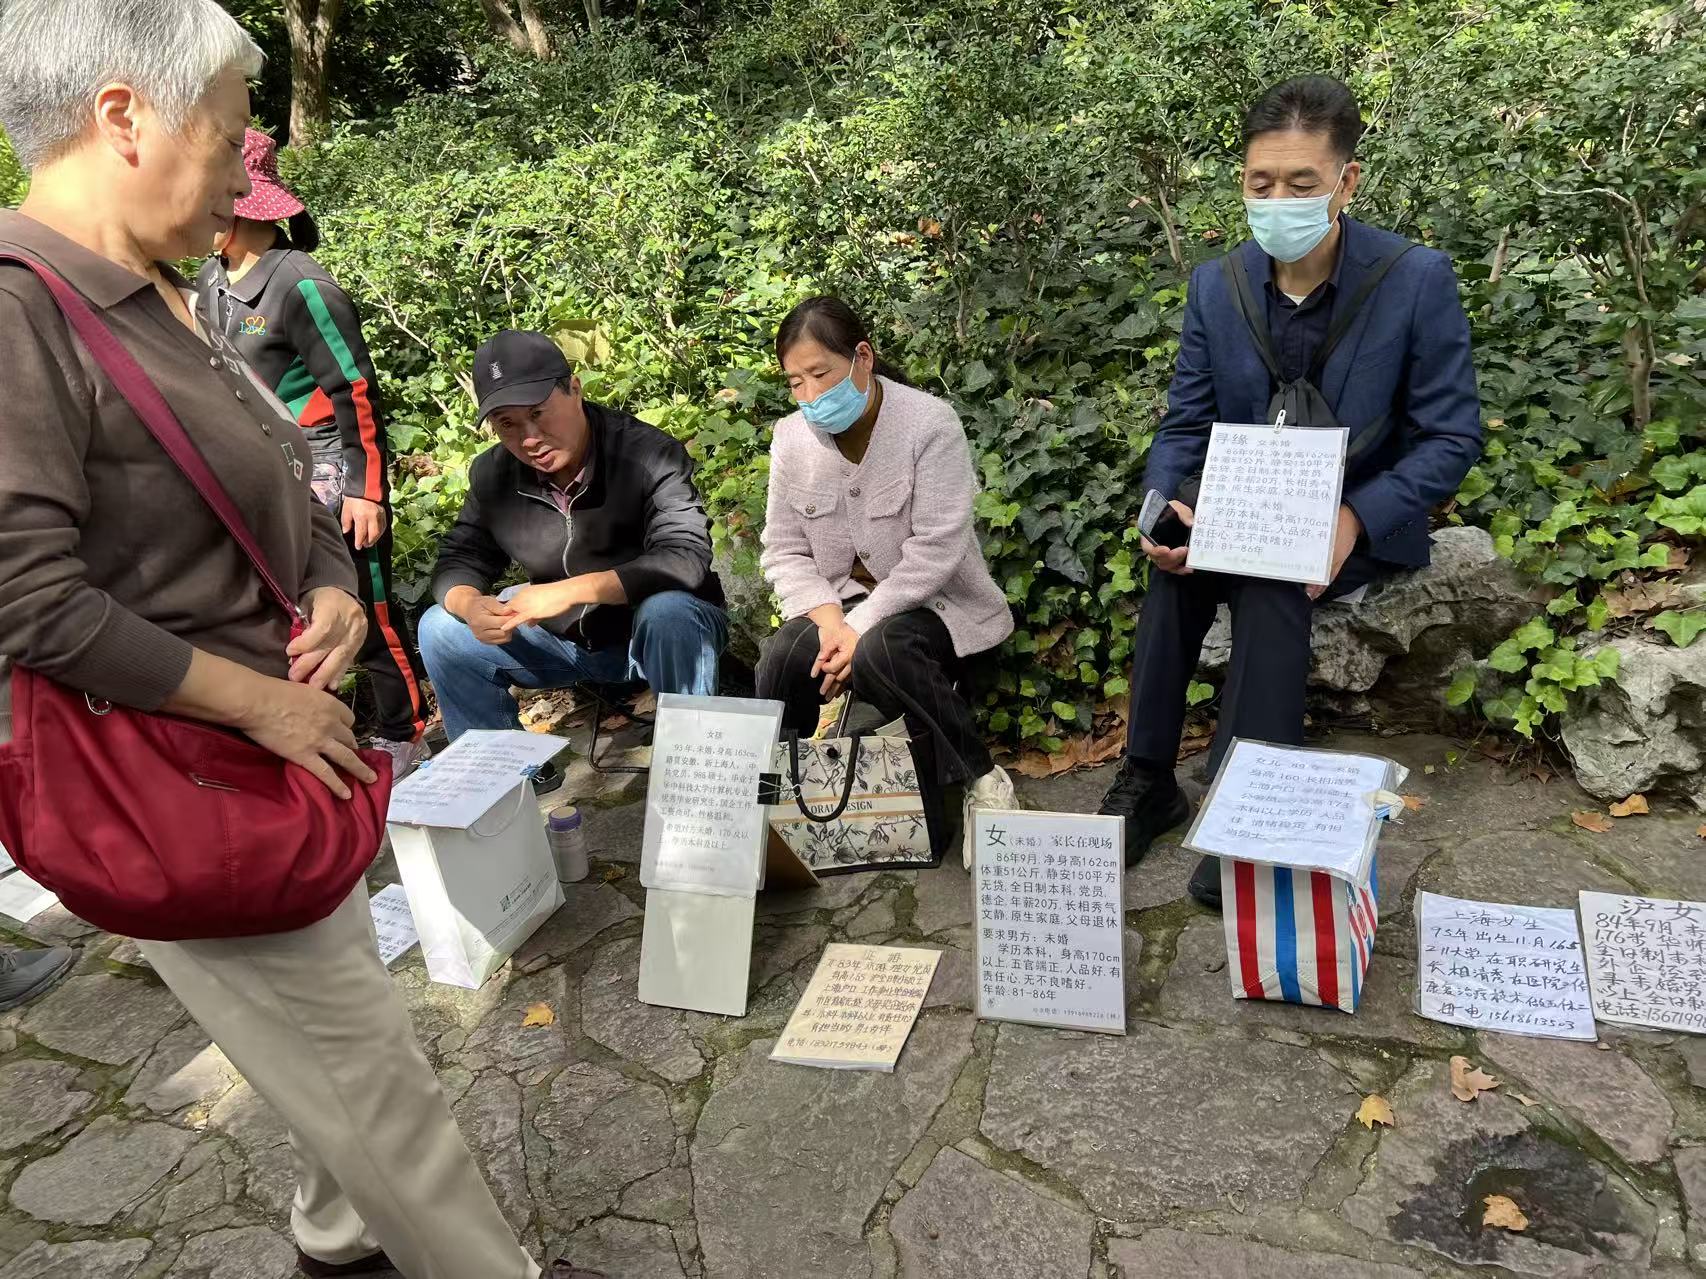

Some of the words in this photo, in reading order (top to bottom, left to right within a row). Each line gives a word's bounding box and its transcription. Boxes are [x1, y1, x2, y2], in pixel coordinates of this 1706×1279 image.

[1216, 433, 1248, 446] 寻缘
[1249, 769, 1275, 779] 身高
[801, 804, 834, 814] ORAL
[846, 801, 872, 811] ESIGN
[985, 824, 1041, 847] 女(未婚)
[1052, 836, 1113, 849] 家长在现场
[1618, 899, 1703, 924] 沪女
[1445, 910, 1545, 931] 上海女生
